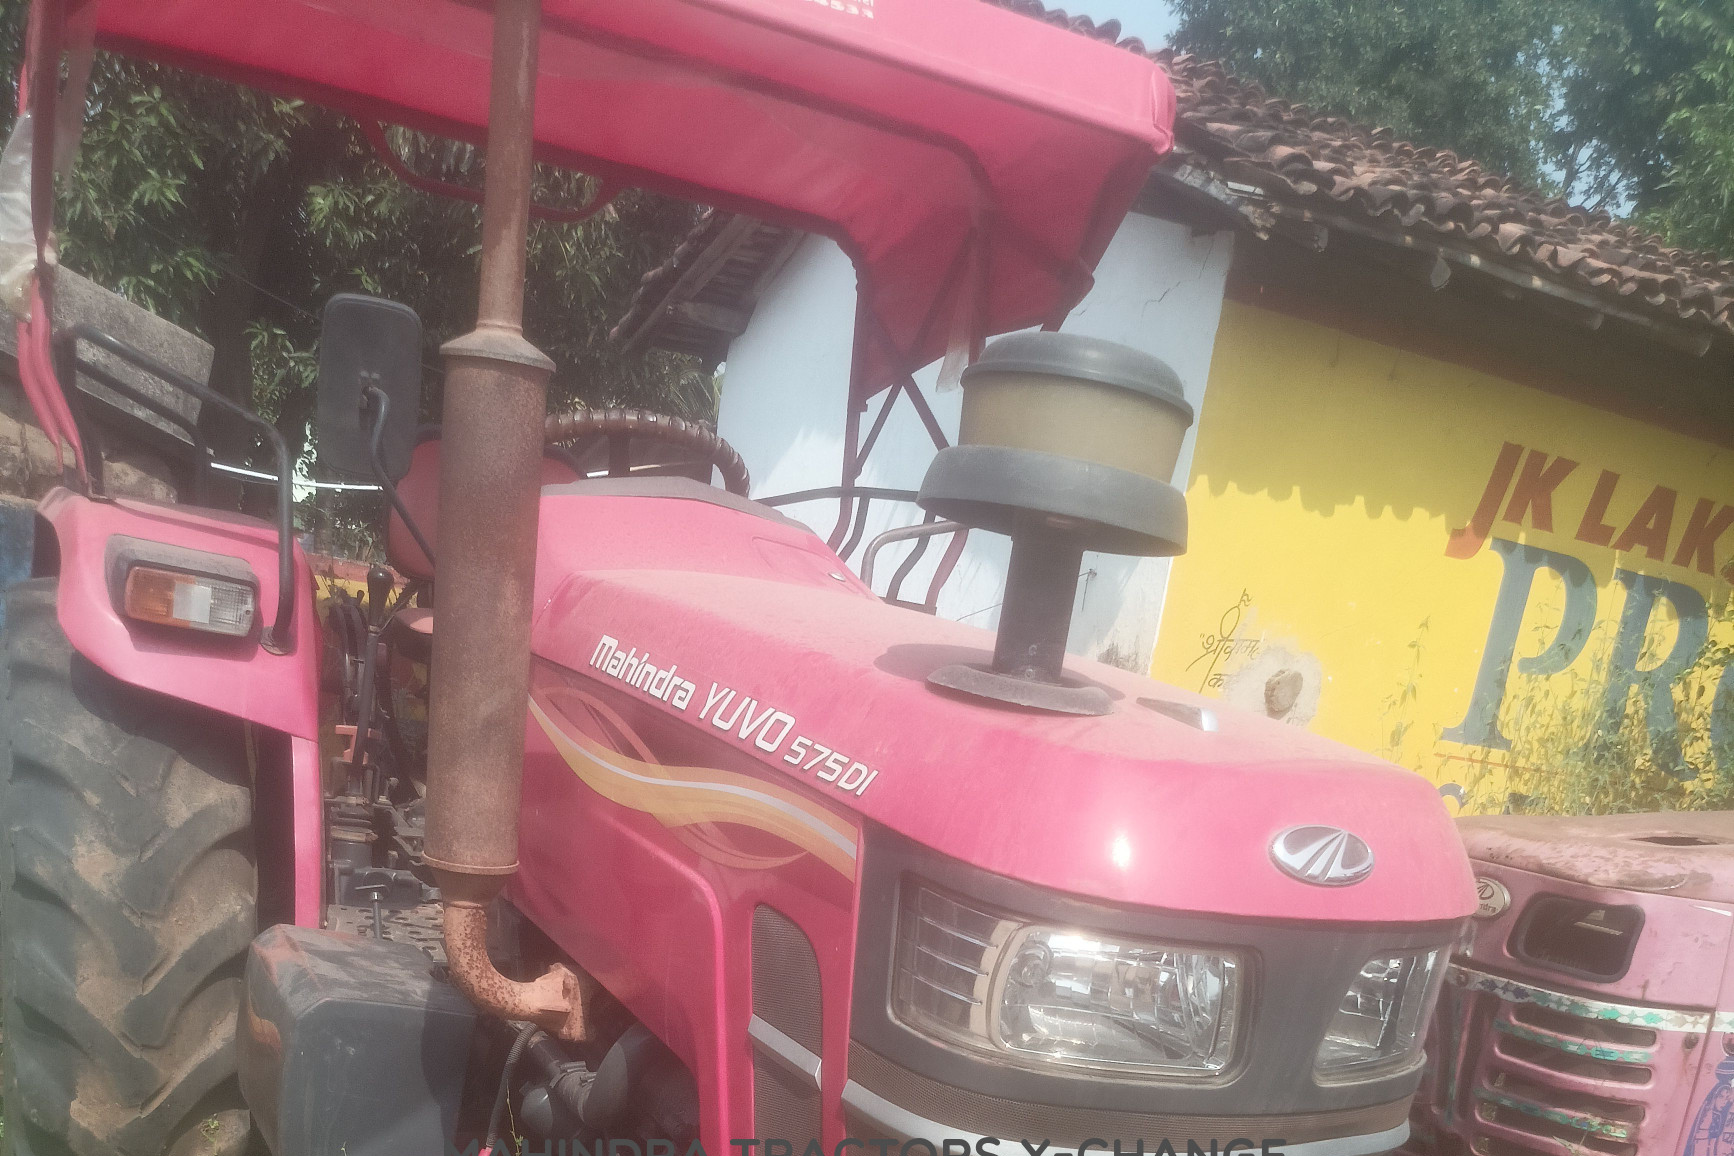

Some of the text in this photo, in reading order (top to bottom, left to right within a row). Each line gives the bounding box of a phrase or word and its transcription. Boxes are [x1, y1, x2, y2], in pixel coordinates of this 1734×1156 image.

[1444, 441, 1734, 586] JK LAK
[589, 634, 879, 796] Mahindra YUVO 575DI
[1440, 537, 1734, 784] PR
